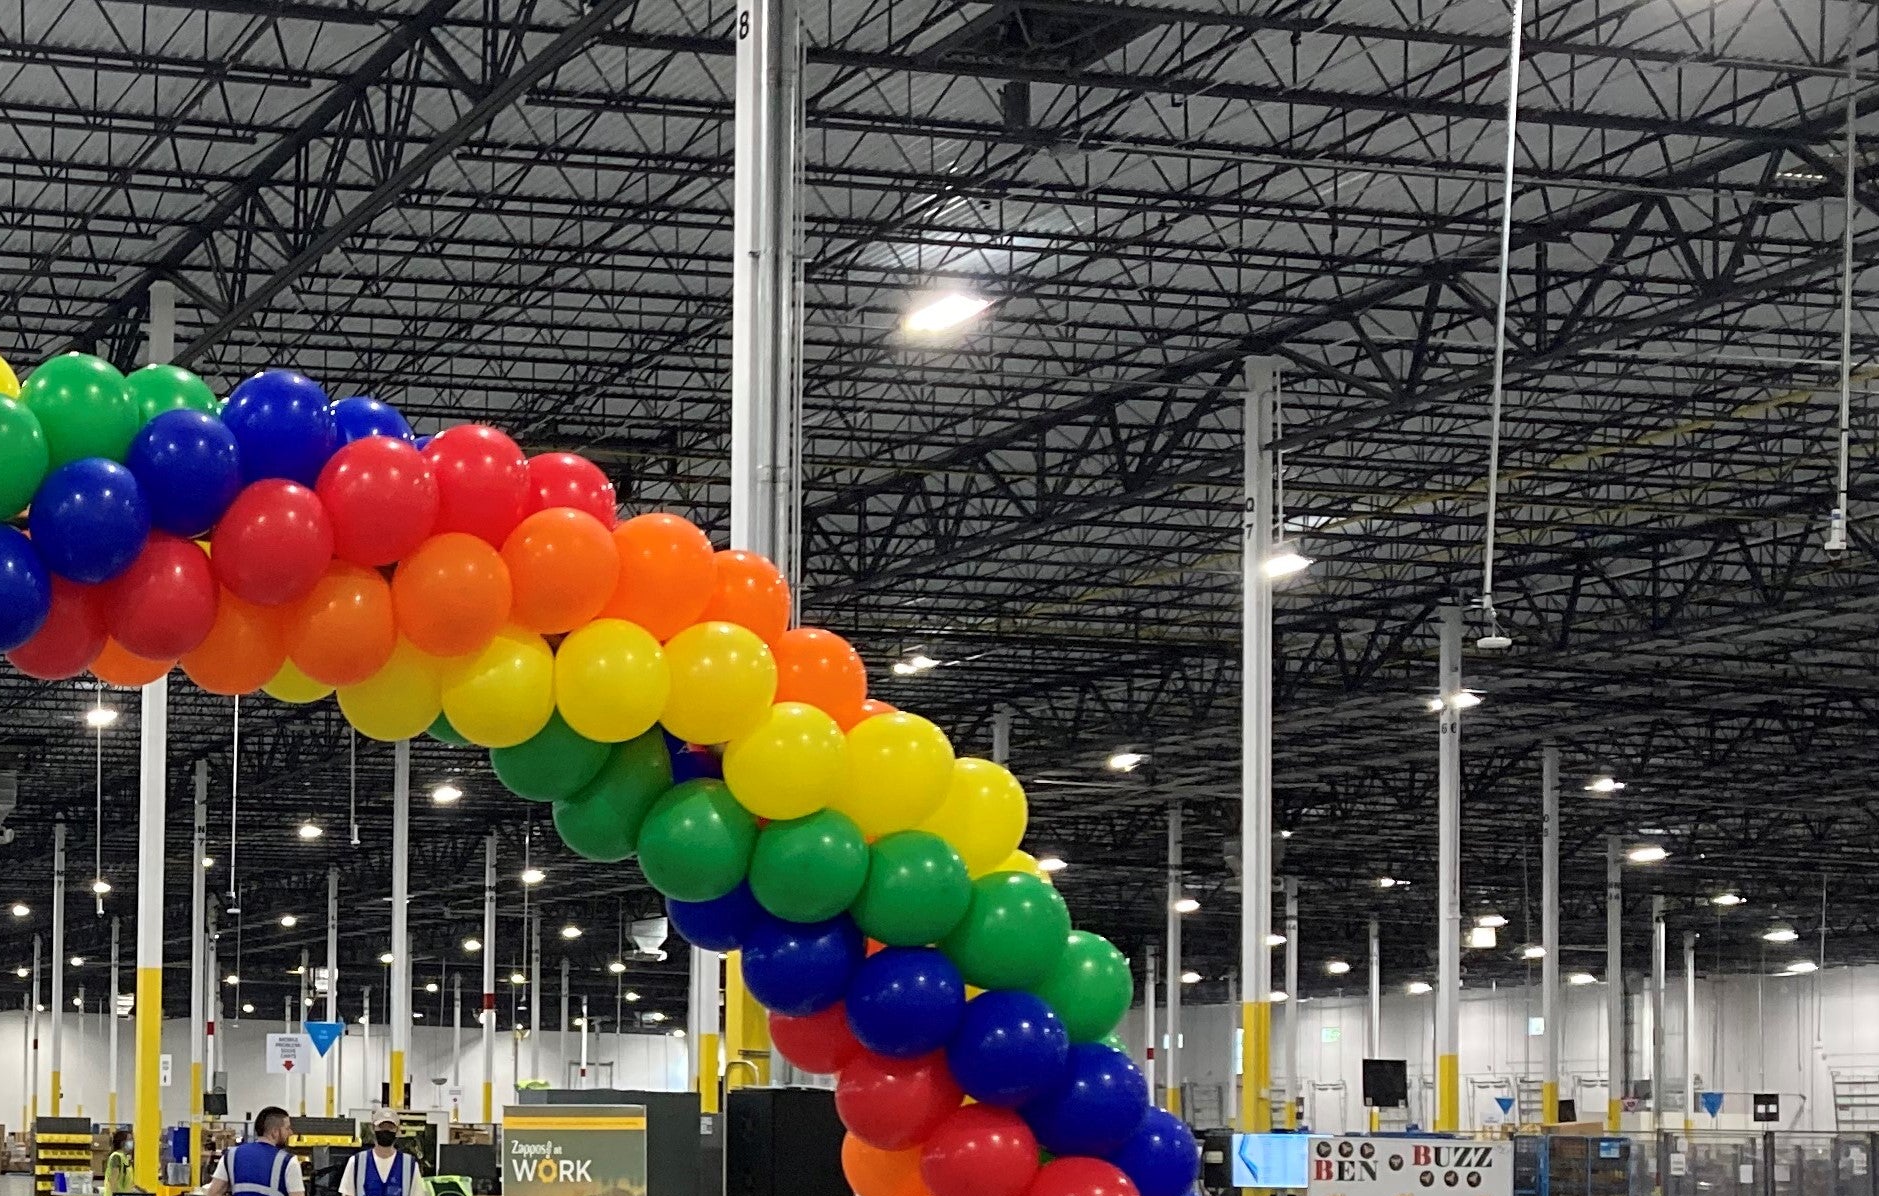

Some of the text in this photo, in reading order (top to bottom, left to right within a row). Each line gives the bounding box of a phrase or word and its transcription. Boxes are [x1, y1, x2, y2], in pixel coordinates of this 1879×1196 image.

[739, 10, 749, 39] 8
[1246, 523, 1253, 539] 7
[511, 1140, 545, 1158] Zappos
[1412, 1145, 1493, 1167] BUZZ
[511, 1158, 593, 1184] WORK
[1313, 1160, 1378, 1182] BEN
